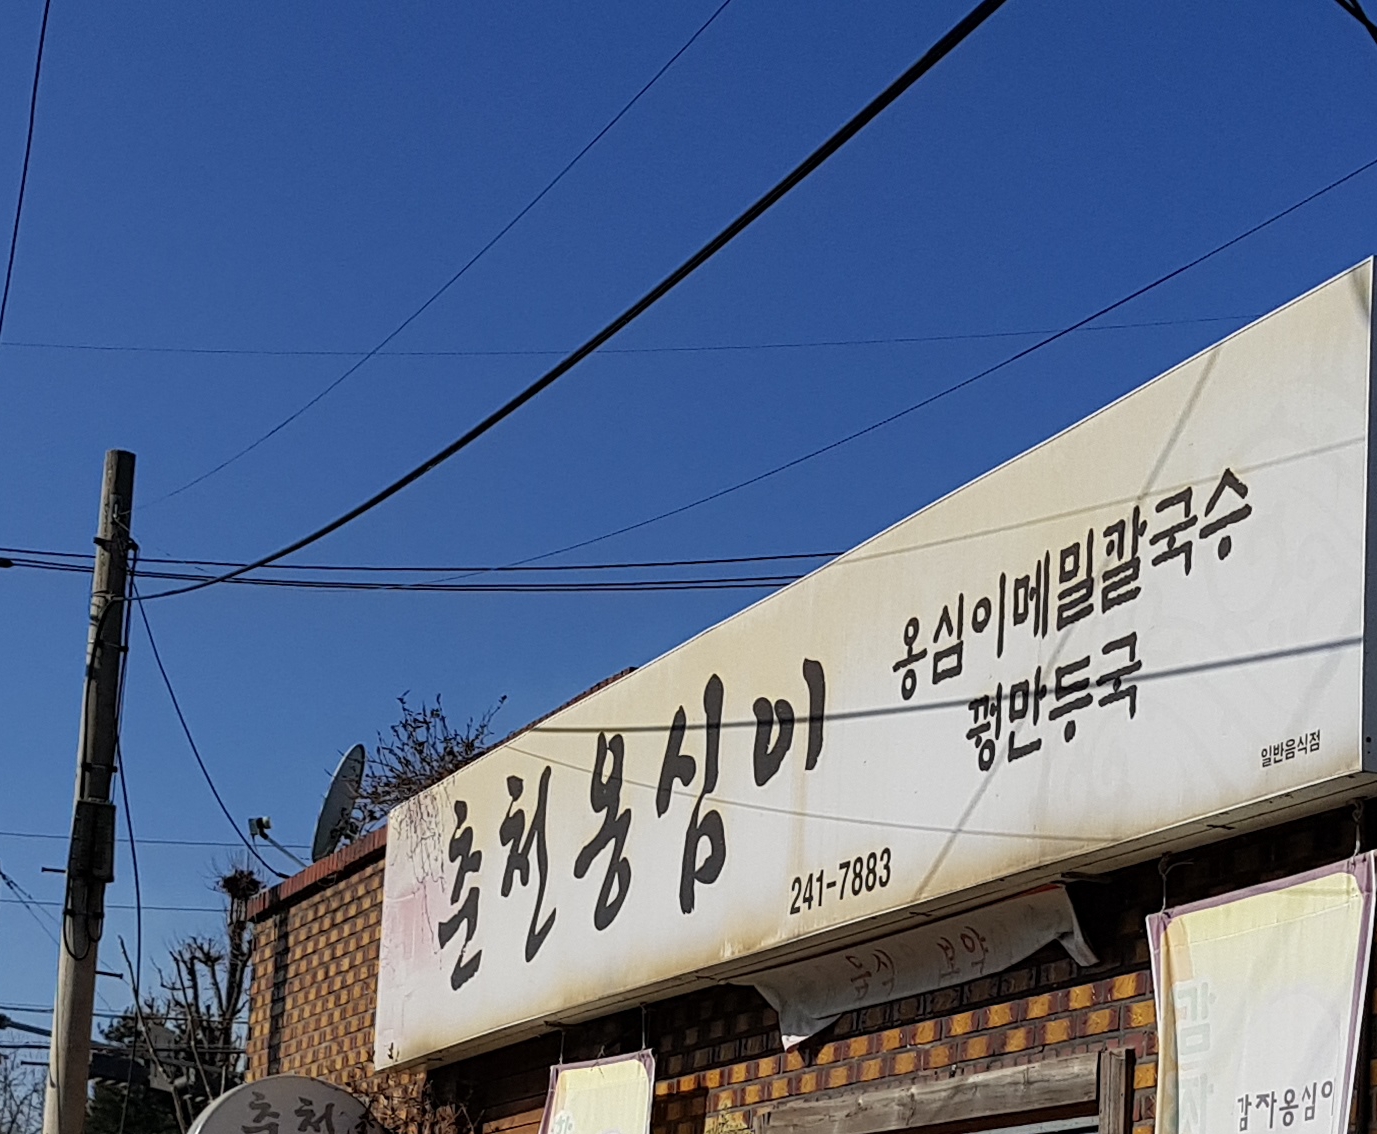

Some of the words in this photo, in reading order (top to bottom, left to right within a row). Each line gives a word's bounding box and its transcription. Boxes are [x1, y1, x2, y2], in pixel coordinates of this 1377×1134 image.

[893, 467, 1253, 701] 옹심이메밀칼국수
[966, 631, 1142, 772] 꿩만두국
[1260, 728, 1321, 768] 일반음식점
[790, 847, 892, 915] 241-7883
[1236, 1080, 1334, 1132] 감자옹심이
